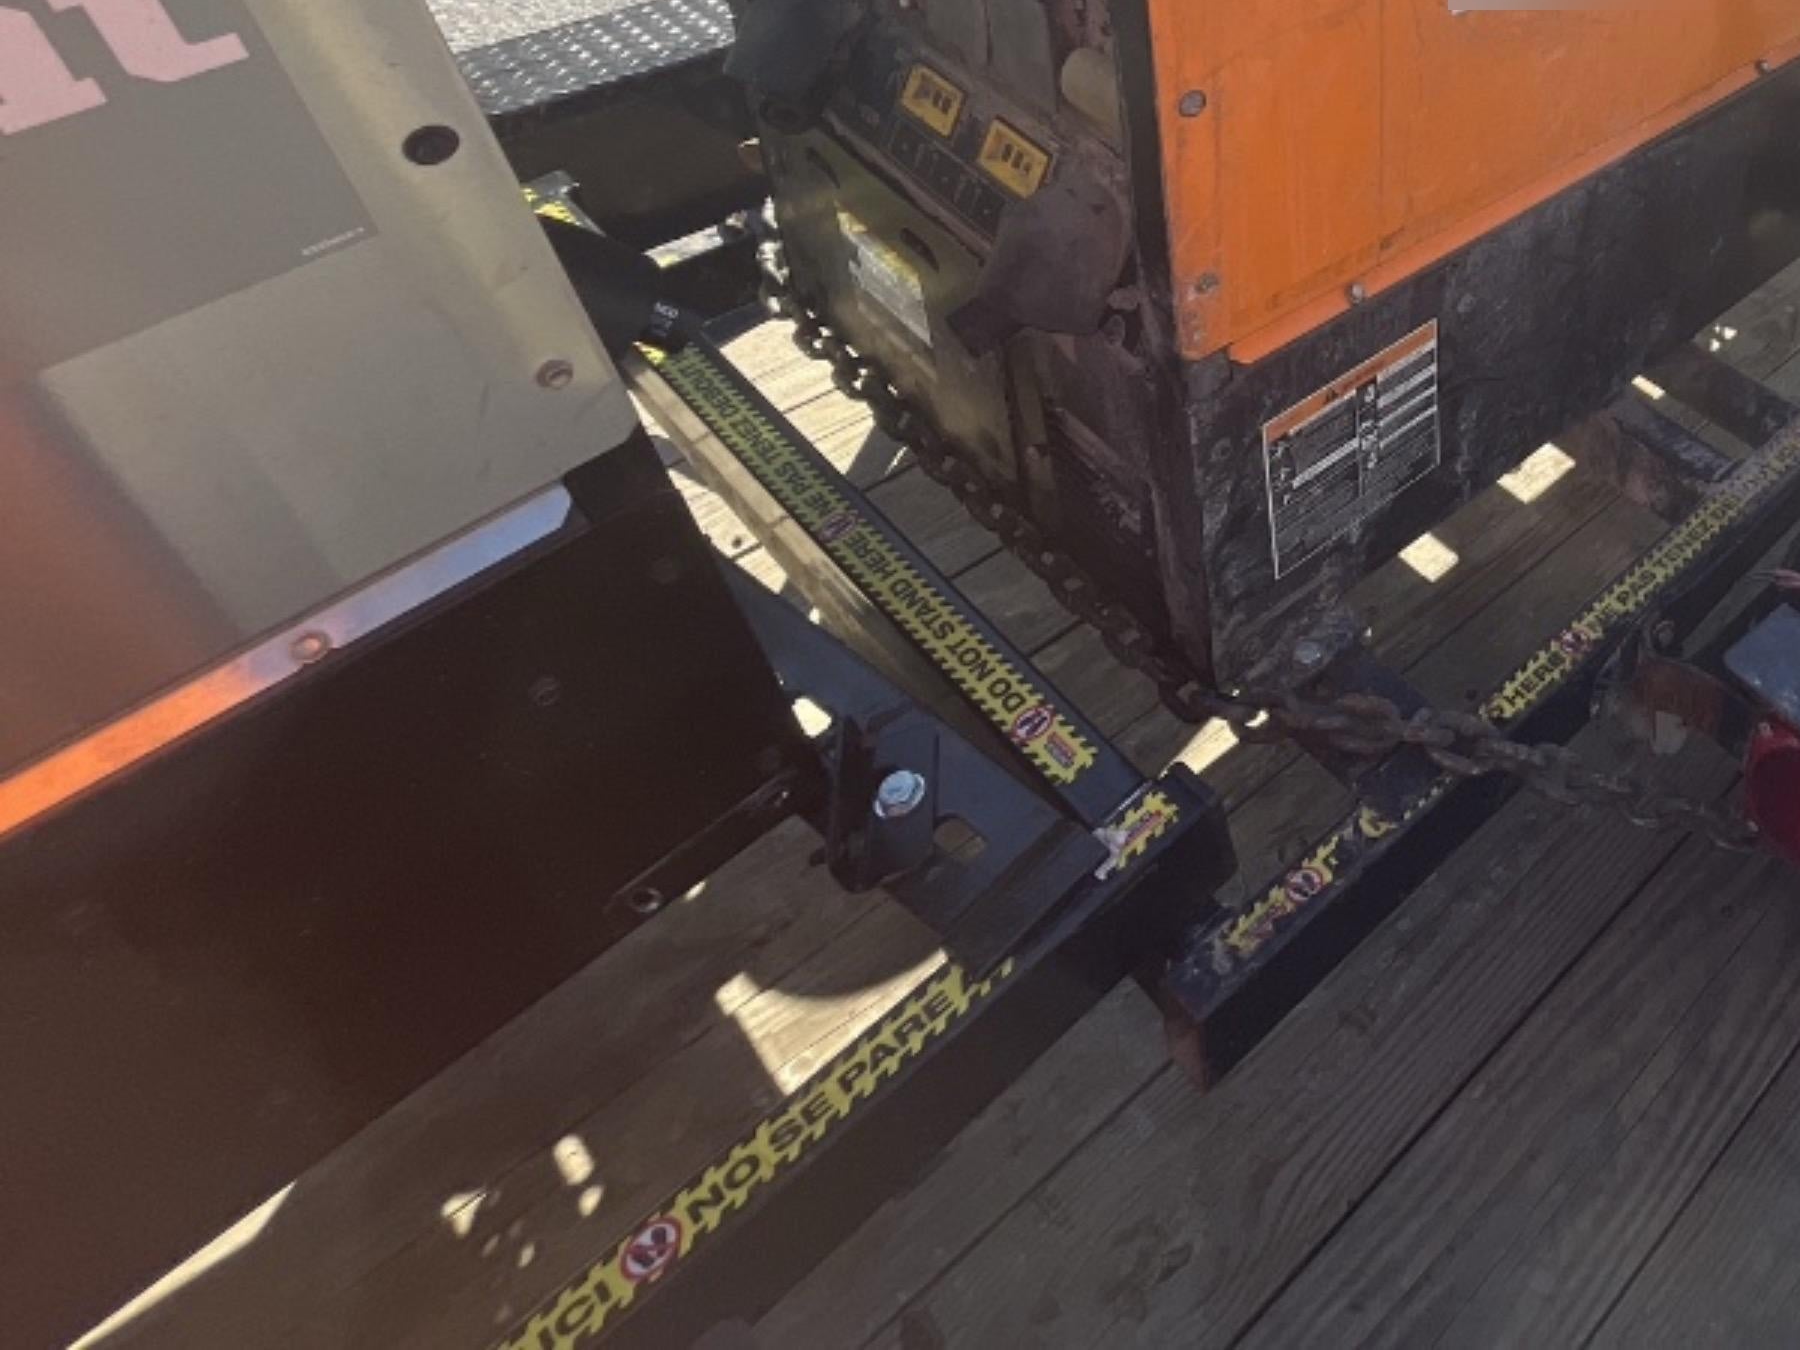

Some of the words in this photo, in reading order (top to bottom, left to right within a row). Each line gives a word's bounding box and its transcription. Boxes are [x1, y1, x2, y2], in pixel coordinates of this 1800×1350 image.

[847, 530, 897, 582] HERE
[888, 576, 957, 642] STAND
[944, 636, 997, 682] NOT
[985, 675, 1027, 714] DO
[687, 1154, 761, 1223] NO
[767, 1091, 836, 1152] SE
[837, 991, 955, 1094] PARE
